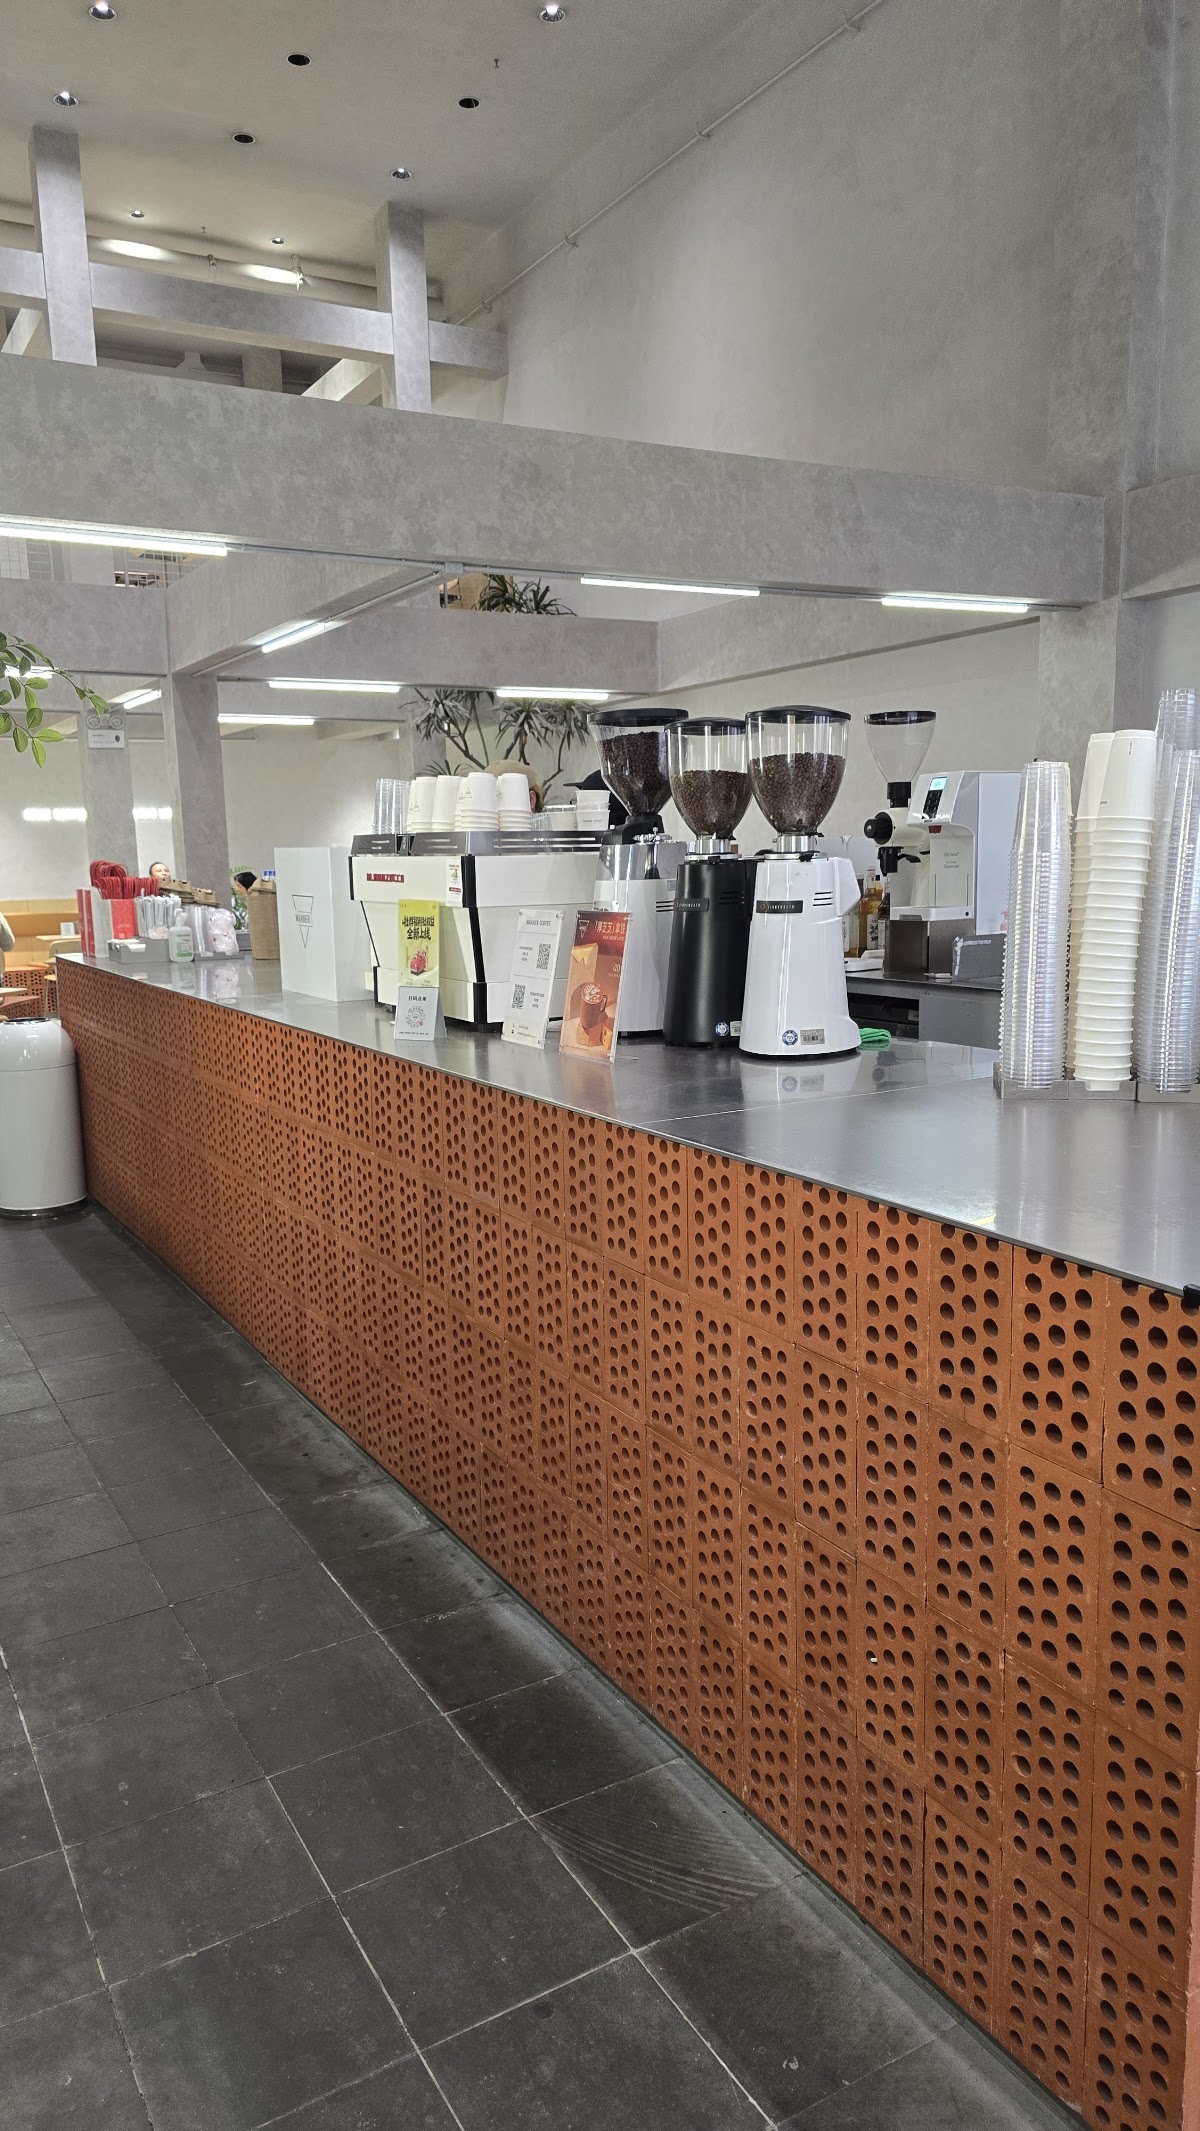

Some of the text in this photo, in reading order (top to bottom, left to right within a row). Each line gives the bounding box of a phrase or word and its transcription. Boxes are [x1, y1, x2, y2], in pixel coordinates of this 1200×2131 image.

[295, 914, 310, 924] MANNER
[407, 927, 431, 941] 全新上线
